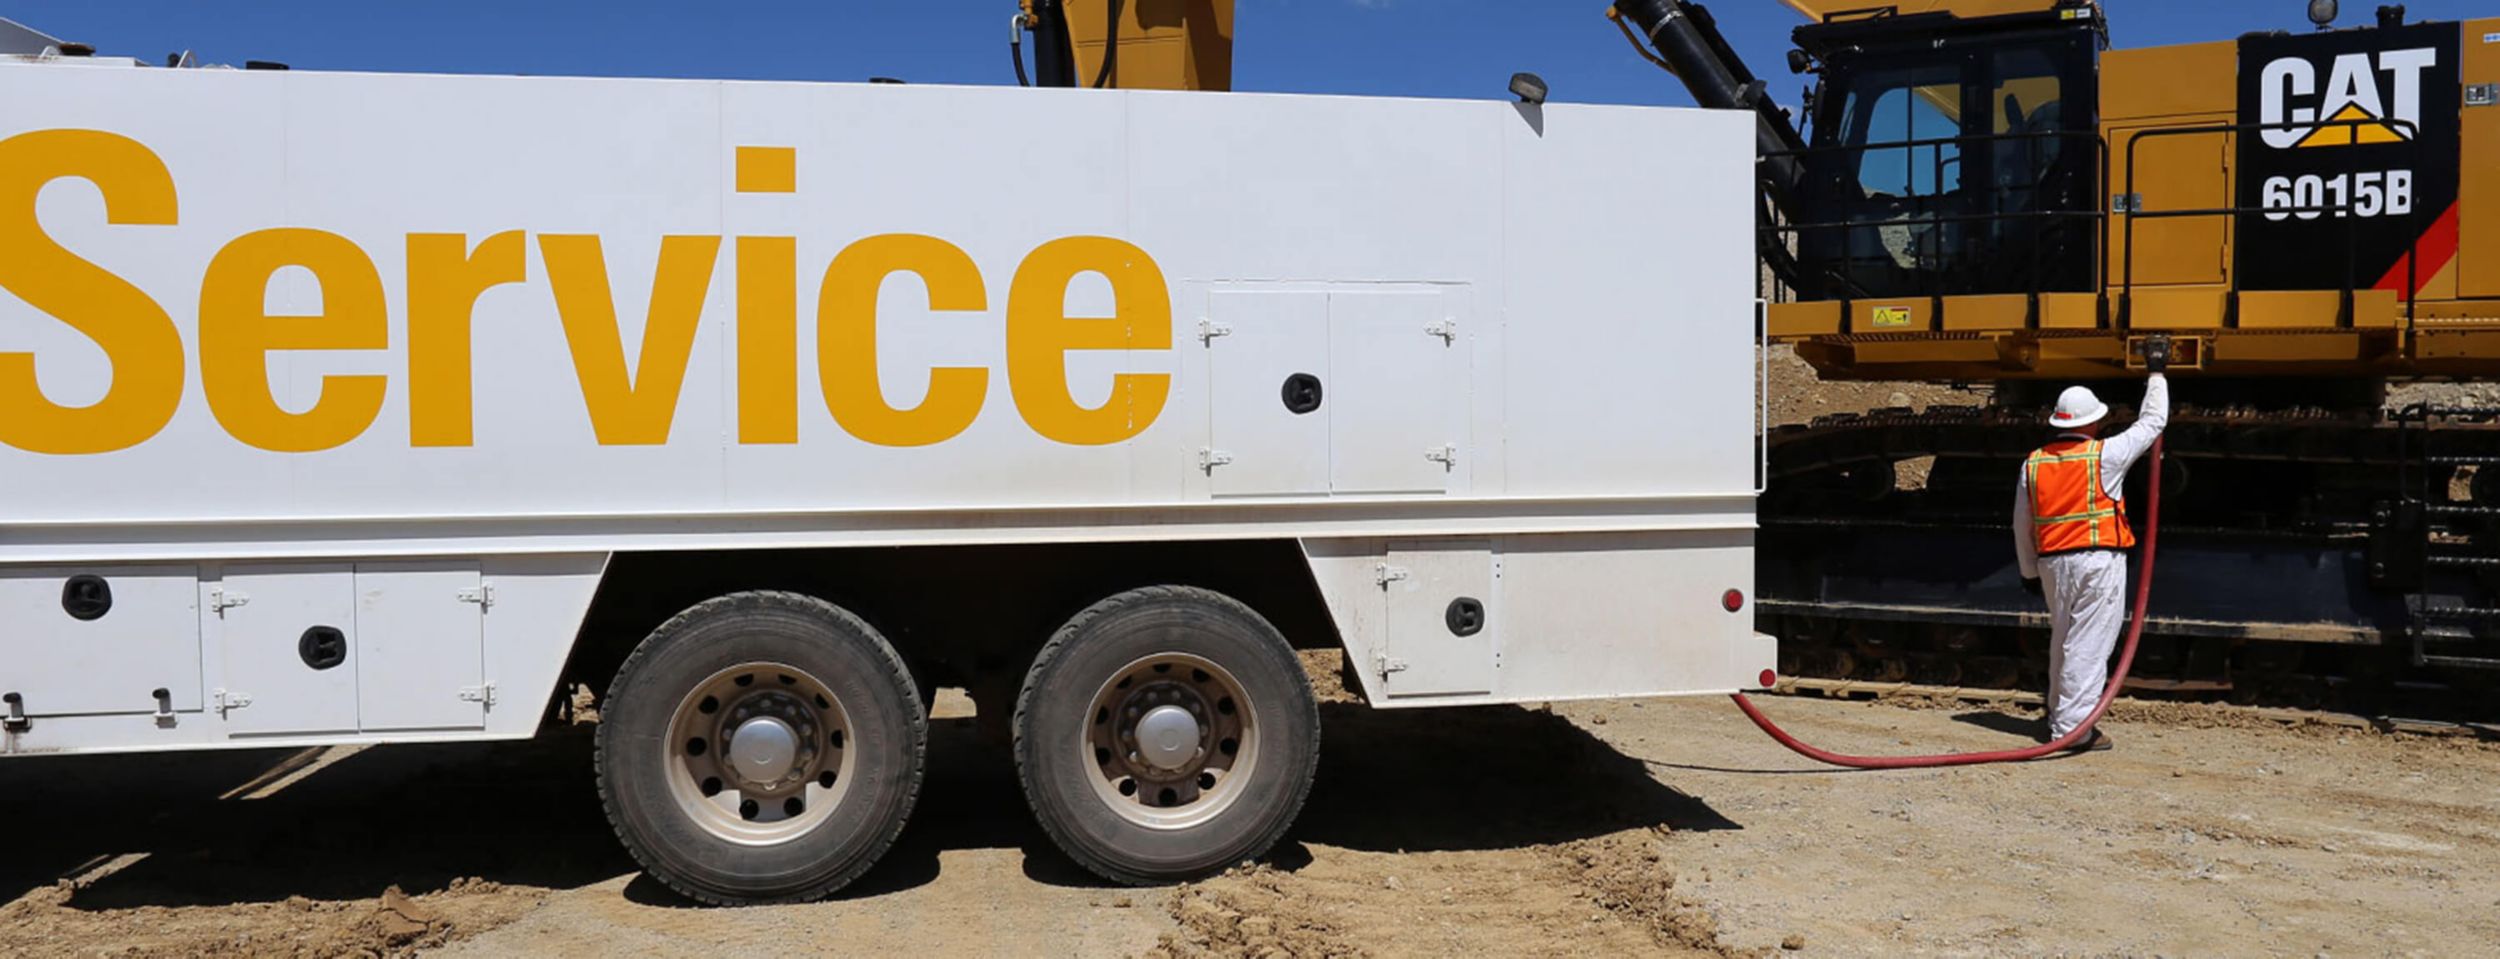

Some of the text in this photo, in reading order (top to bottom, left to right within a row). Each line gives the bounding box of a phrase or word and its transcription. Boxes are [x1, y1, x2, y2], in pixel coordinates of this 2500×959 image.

[2260, 47, 2436, 149] CAT
[2262, 169, 2412, 221] 6015B
[0, 128, 1172, 455] Service
